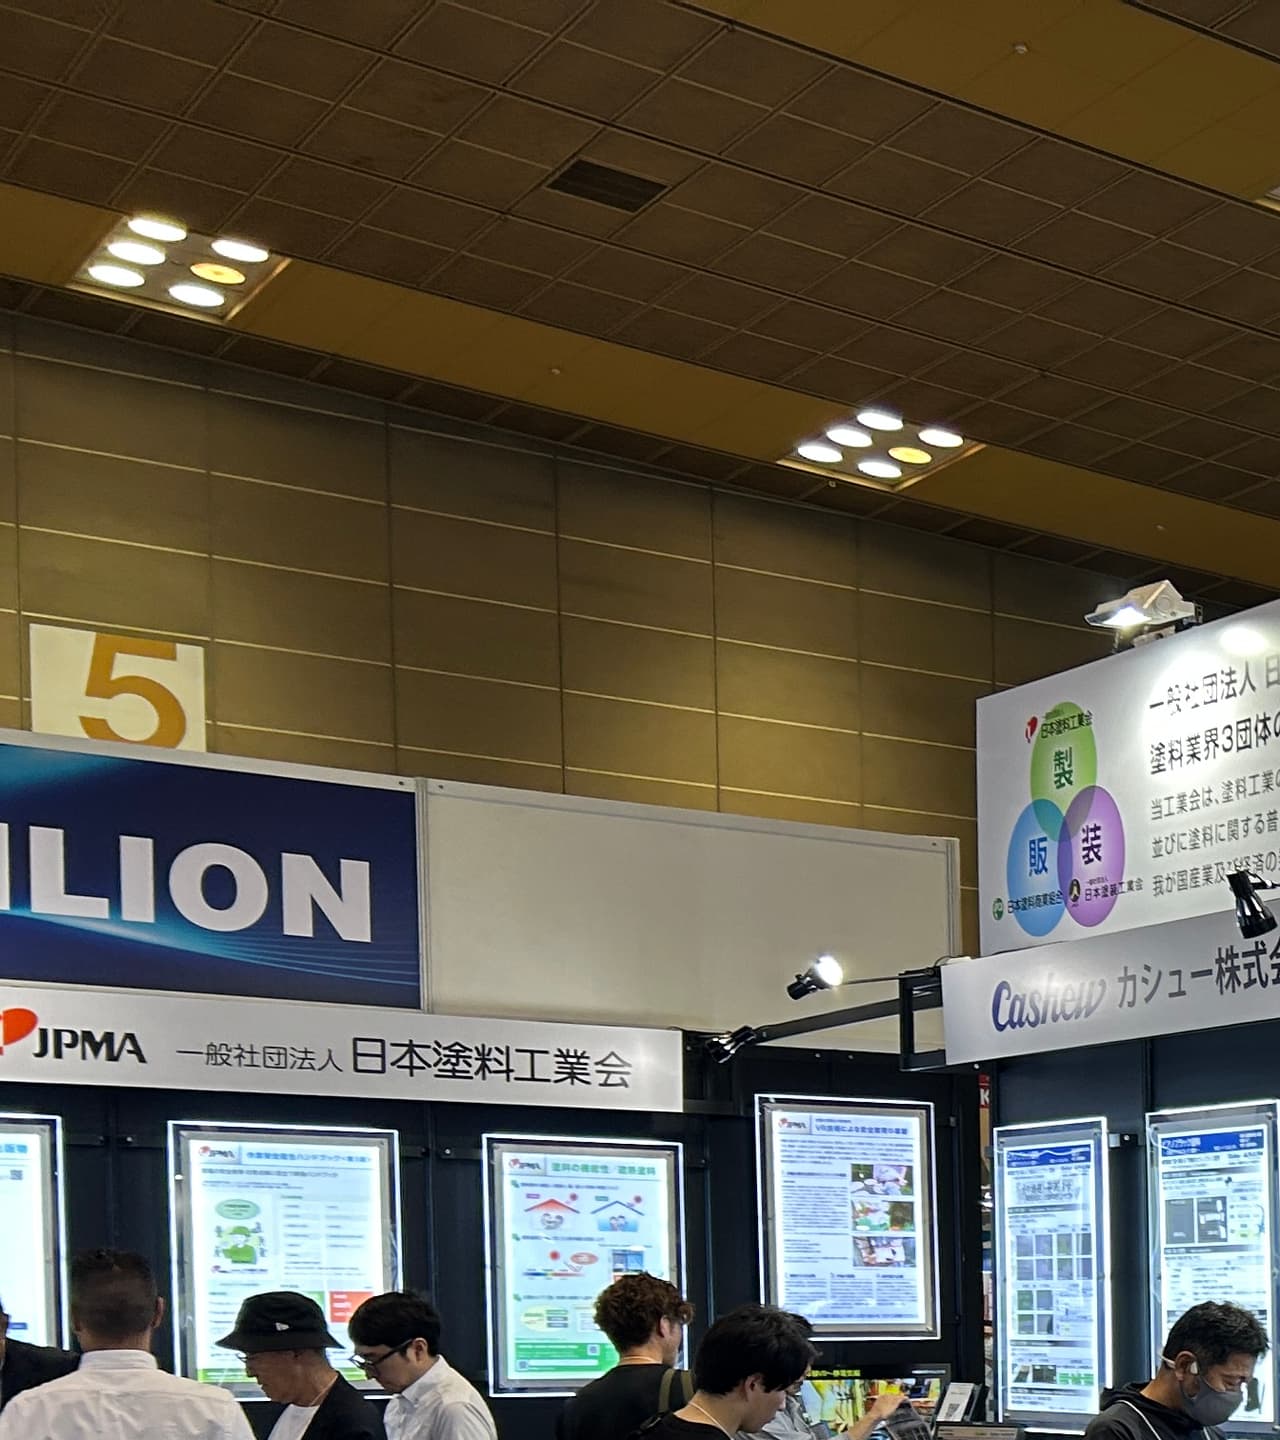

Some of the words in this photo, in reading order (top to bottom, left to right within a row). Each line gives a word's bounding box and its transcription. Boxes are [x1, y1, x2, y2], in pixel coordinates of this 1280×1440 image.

[79, 634, 188, 749] 5
[1054, 747, 1074, 789] 製
[1028, 836, 1049, 877] 販
[1082, 823, 1102, 865] 装
[992, 973, 1106, 1032] Cashew
[33, 1028, 147, 1066] JPMA
[176, 1042, 343, 1075] 一般社団法人
[352, 1037, 634, 1090] 日本塗料工業会
